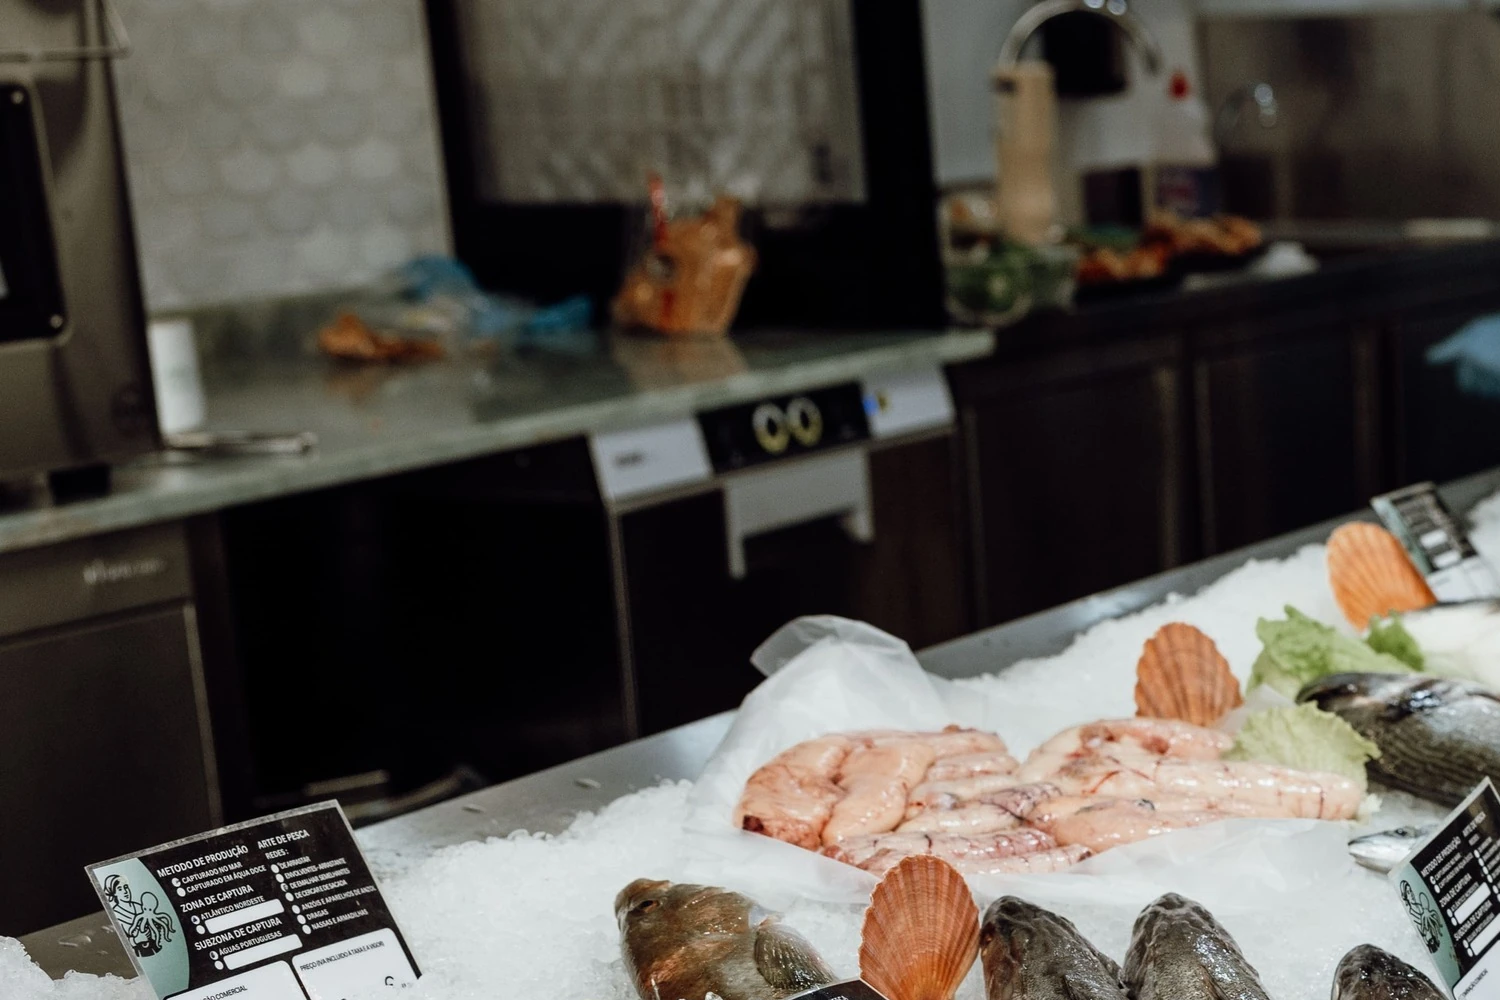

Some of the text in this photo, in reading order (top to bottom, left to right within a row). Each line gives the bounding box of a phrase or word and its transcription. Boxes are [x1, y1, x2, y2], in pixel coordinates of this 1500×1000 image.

[257, 829, 310, 849] ARTE DE PESCA
[157, 845, 248, 877] METODO DE PRODUÇÃO
[182, 861, 242, 884] CAPTURADO NO MAR
[186, 877, 224, 893] CAPTURADO
[223, 874, 233, 882] EM
[249, 865, 266, 875] DOCE
[180, 885, 254, 912] ZONA DE CAPTURA
[201, 895, 265, 920] ATLÂNTICO NORDESTE
[194, 917, 282, 950] SUBZONA DE CAPTURA
[219, 931, 282, 955] ÁGUAS PORTUGUESAS
[215, 986, 247, 1000] COMERCIAL
